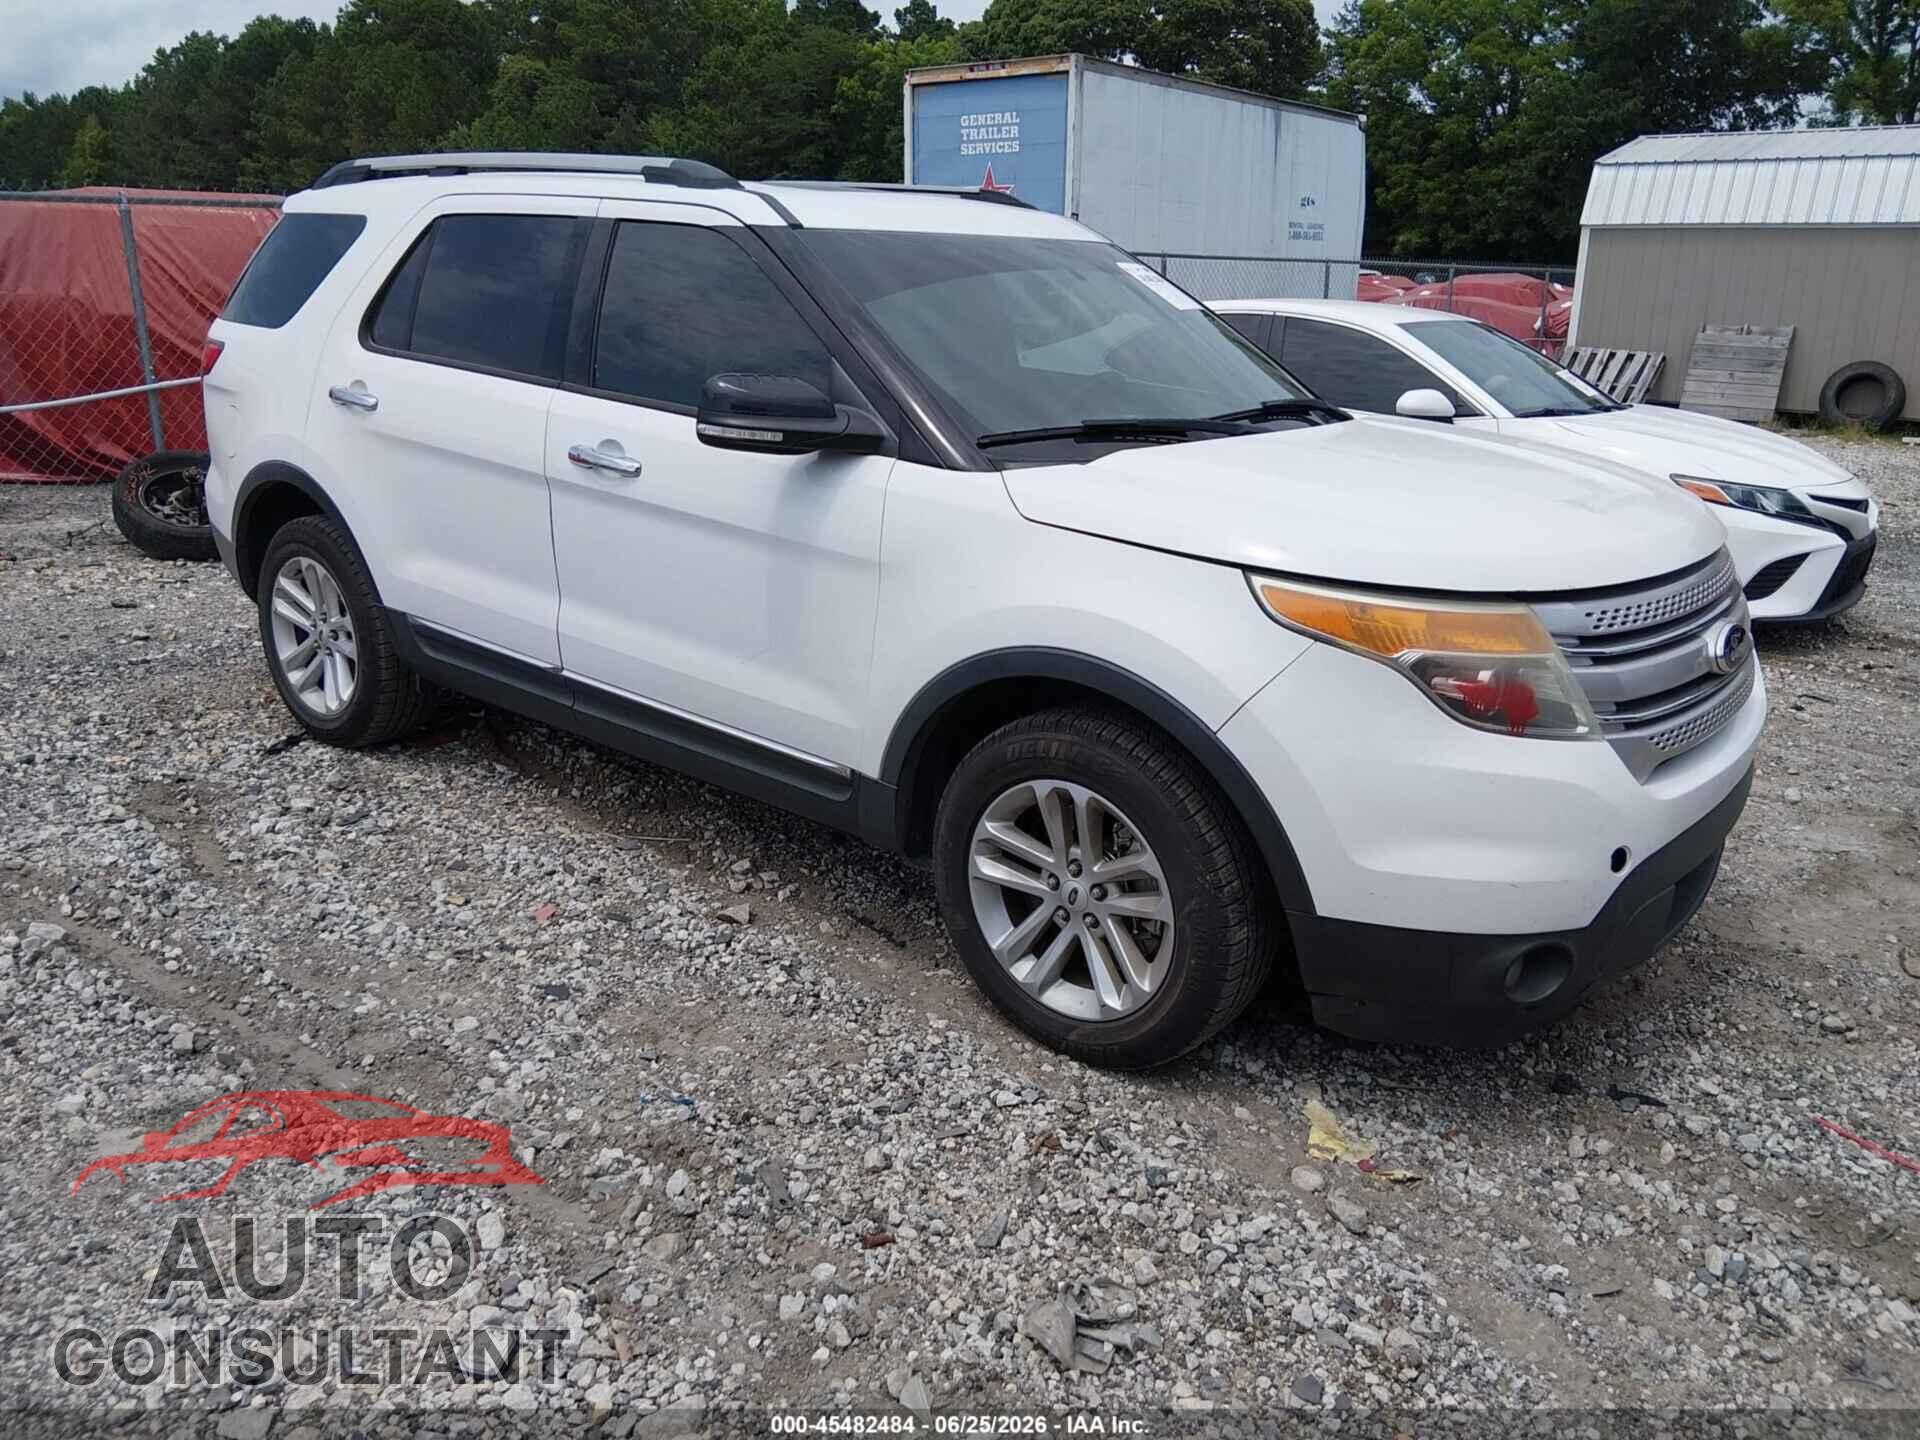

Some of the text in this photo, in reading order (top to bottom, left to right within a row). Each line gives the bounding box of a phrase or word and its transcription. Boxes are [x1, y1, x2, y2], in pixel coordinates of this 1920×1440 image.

[960, 112, 1020, 126] GENERAL
[960, 126, 1019, 140] TRAILER
[960, 141, 1020, 155] SERVICES
